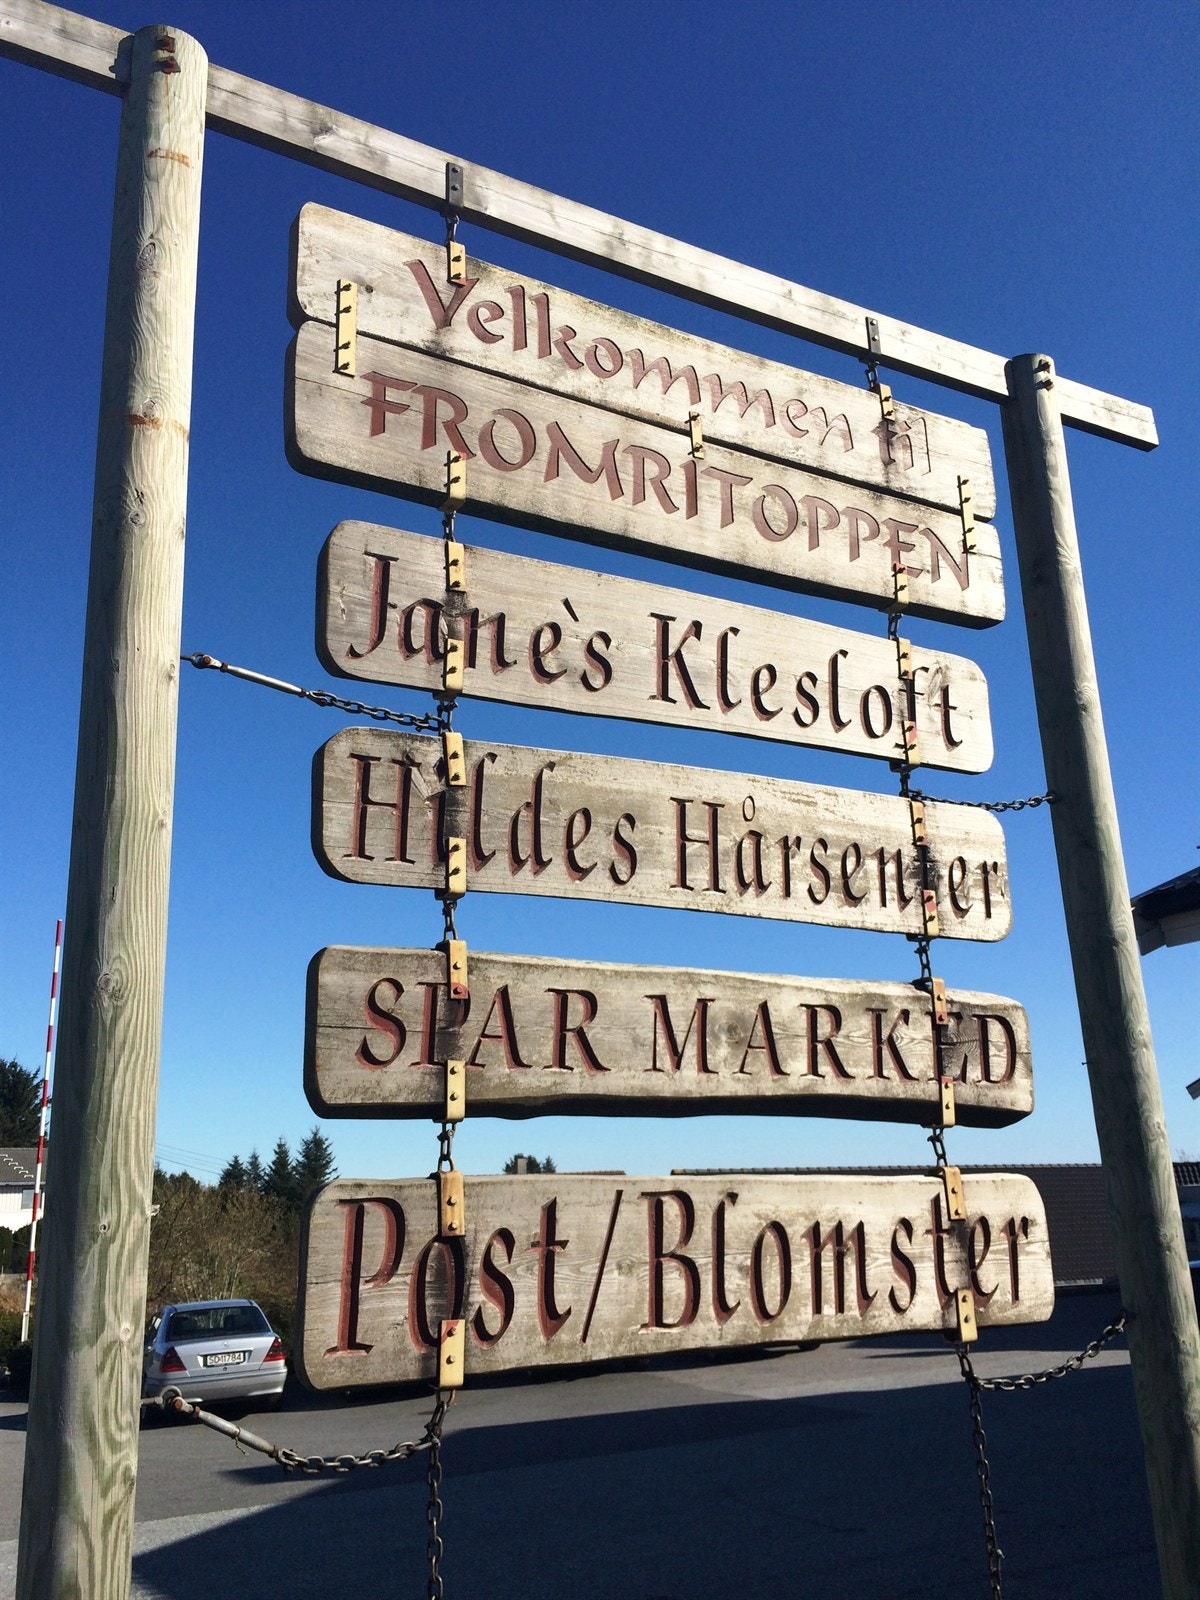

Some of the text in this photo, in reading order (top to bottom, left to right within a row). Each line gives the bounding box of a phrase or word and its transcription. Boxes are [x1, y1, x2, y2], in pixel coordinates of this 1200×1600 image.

[403, 259, 932, 476] Velkommen til
[361, 371, 970, 590] FROMRITOPPEN
[649, 612, 963, 753] Klesloft
[345, 751, 636, 886] Hildes
[355, 977, 1017, 1084] SPAR MARKED
